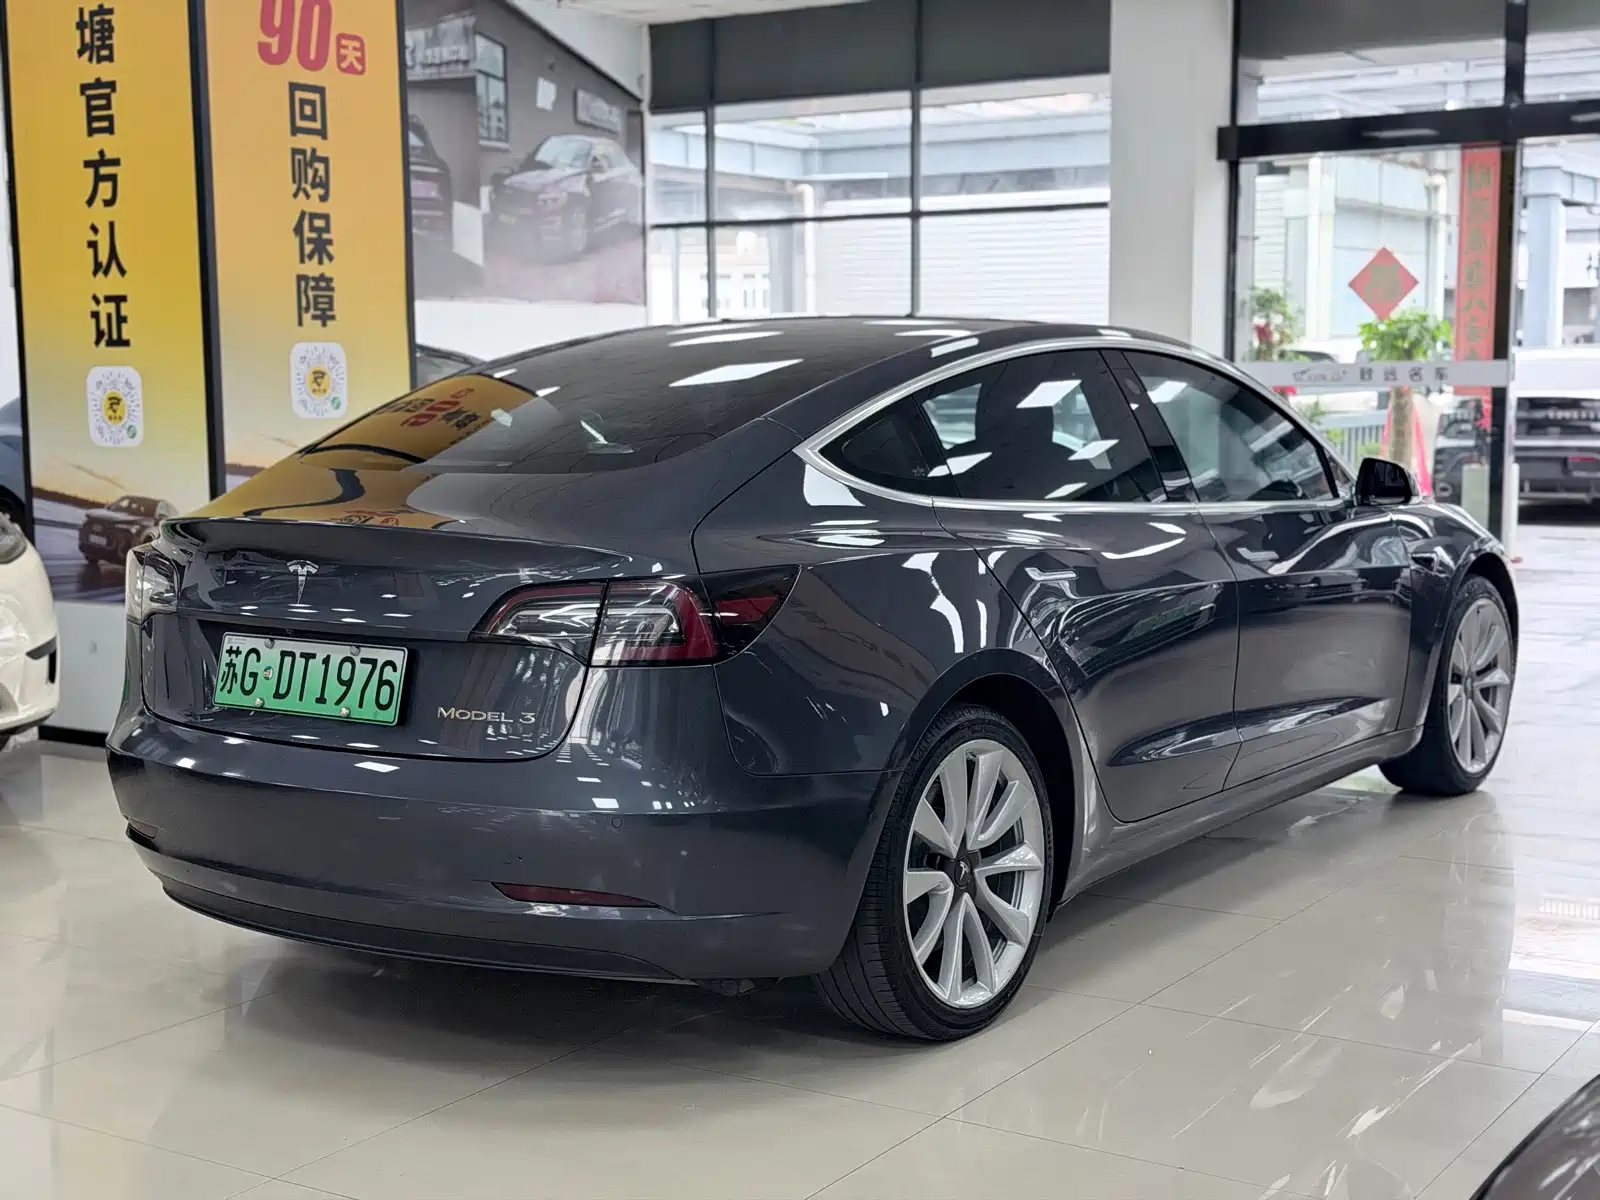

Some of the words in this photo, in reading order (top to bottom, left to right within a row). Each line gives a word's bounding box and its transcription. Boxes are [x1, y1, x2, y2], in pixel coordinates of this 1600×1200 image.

[76, 3, 131, 348] 塘官方认证
[288, 81, 337, 328] 回购保障
[519, 712, 536, 724] 3
